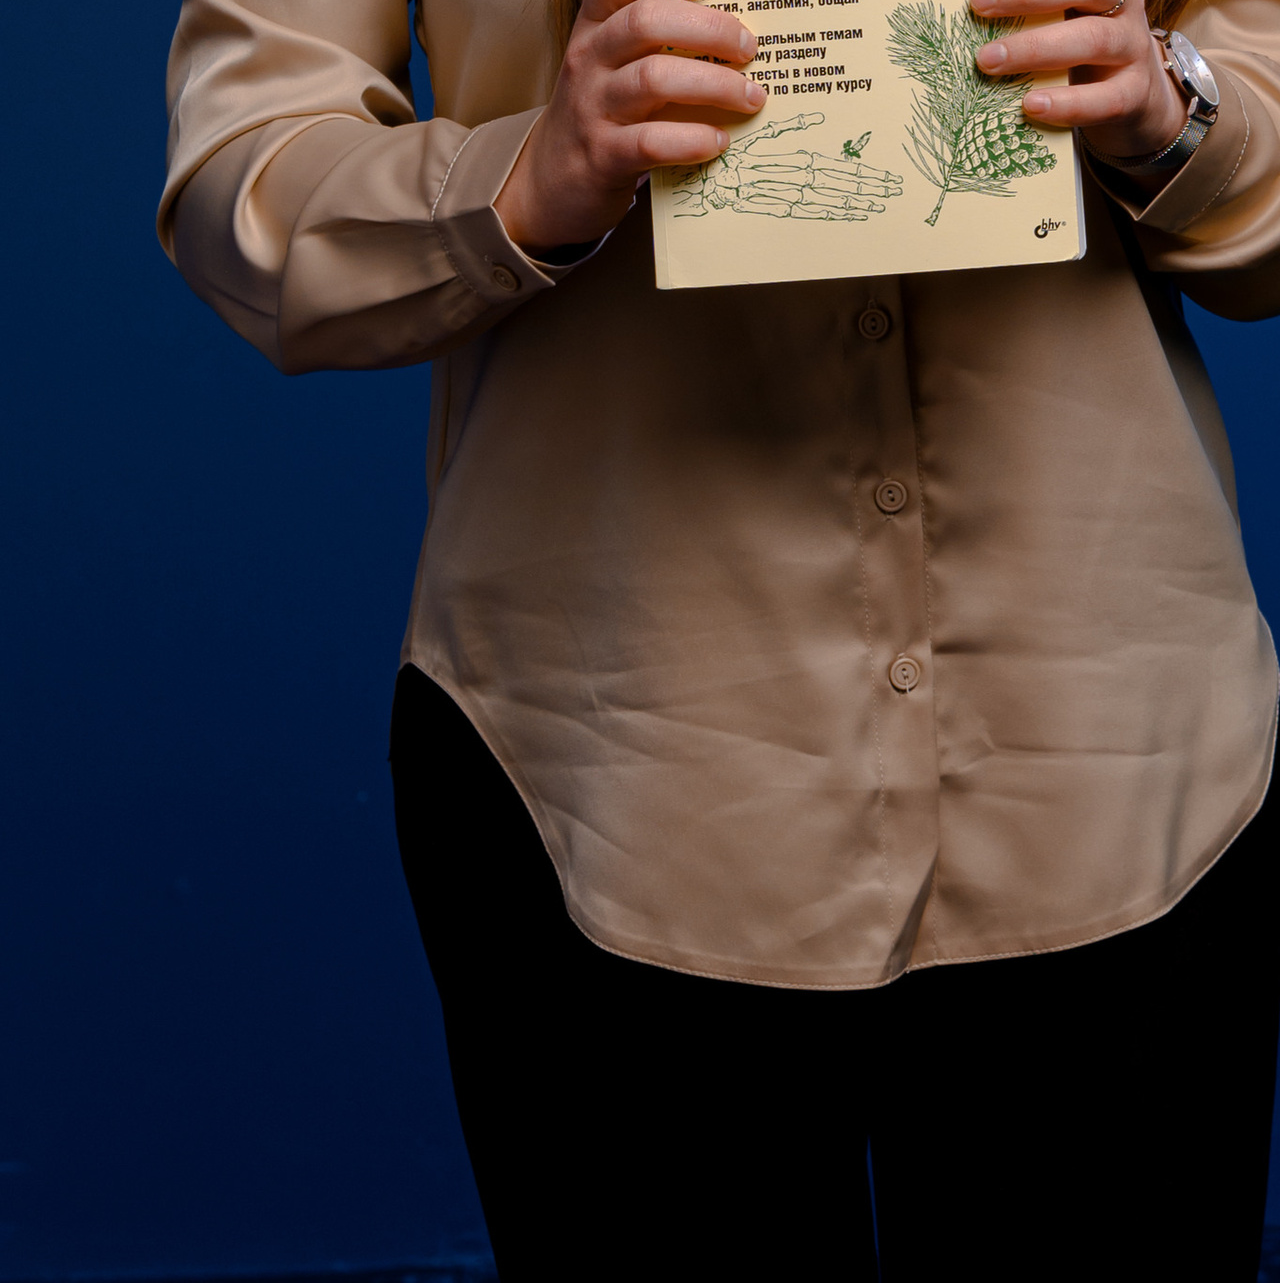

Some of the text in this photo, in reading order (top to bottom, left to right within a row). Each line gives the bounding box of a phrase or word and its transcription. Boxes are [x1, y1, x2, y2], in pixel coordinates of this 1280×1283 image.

[755, 29, 863, 47] дельным темам
[775, 46, 827, 63] разделу
[750, 69, 789, 81] тесты
[793, 68, 801, 78] в
[804, 65, 845, 77] новом
[773, 84, 789, 95] по
[792, 81, 832, 94] всему
[836, 78, 872, 93] курсу
